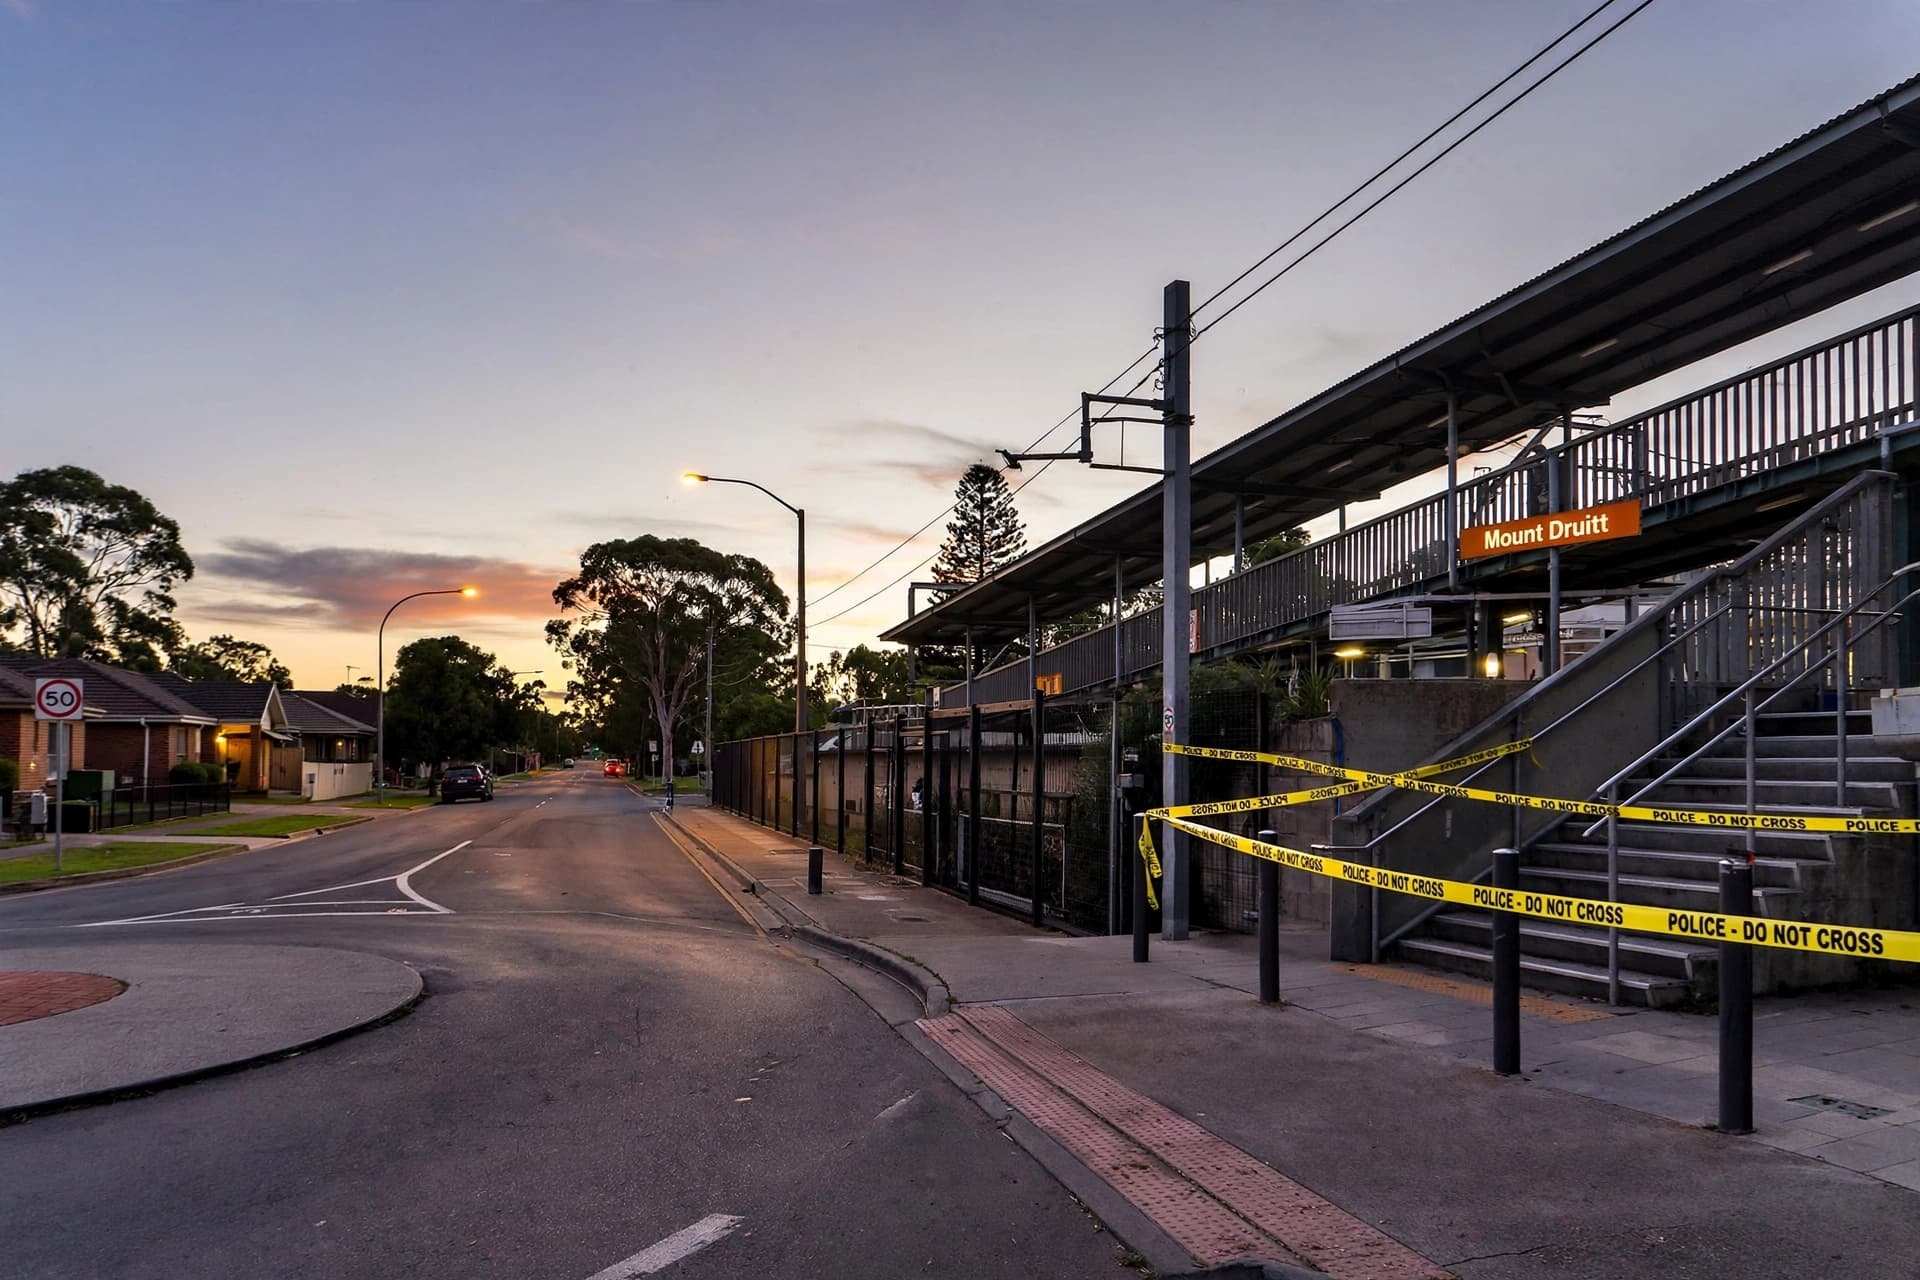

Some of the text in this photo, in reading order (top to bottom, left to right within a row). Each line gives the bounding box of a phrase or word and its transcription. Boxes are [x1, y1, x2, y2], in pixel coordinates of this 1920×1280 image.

[1484, 513, 1609, 549] Mount Druitt
[46, 691, 74, 707] 50
[1366, 774, 1396, 786] POLICE
[1418, 782, 1436, 793] NOT
[1438, 784, 1469, 798] CROSS
[1495, 794, 1621, 817] POLICE DO NOT CROSS
[1652, 810, 1807, 829] POLICE DO NOT CROSS
[1846, 820, 1900, 832] POLICE
[1252, 842, 1323, 872] POLICE DO NOT CROSS
[1343, 864, 1444, 898] POLICE DO NOT CROSS
[1473, 887, 1623, 925] POLICE DO NOT CROSS
[1668, 912, 1884, 955] POLICE DO NOT CROSS
